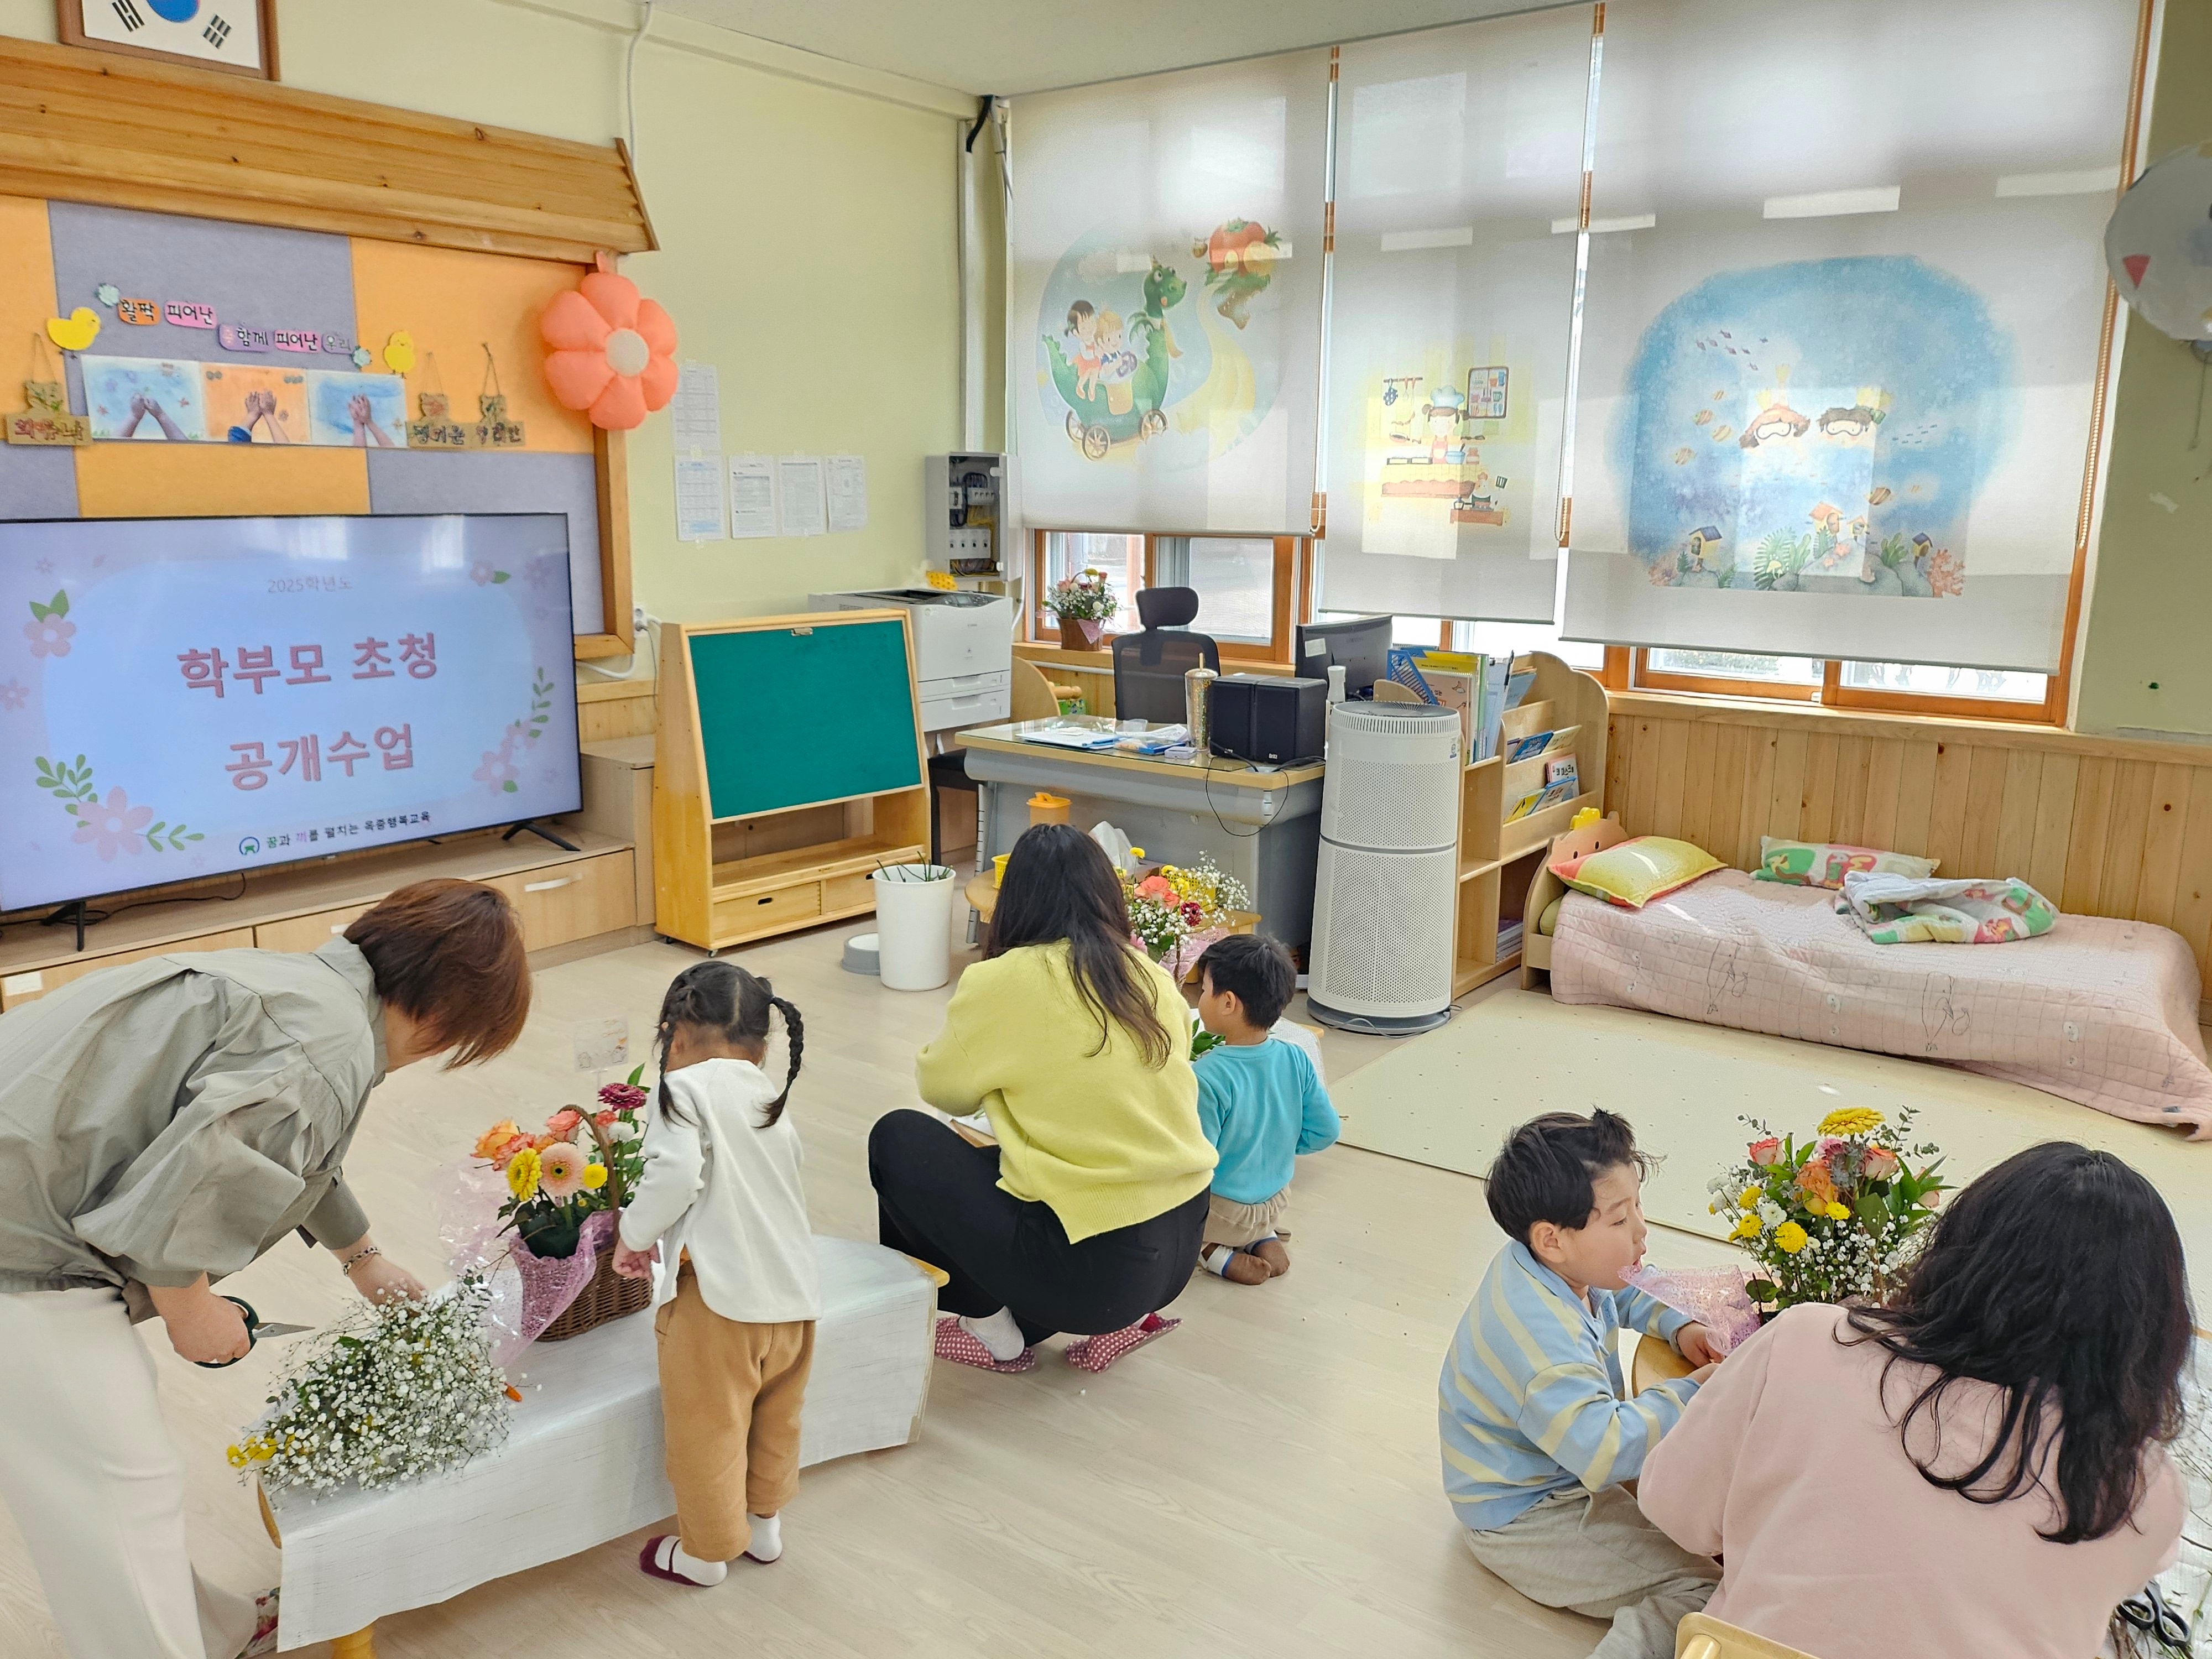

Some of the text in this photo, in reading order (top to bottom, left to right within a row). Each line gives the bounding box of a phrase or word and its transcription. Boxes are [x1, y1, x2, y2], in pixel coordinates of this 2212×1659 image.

[119, 299, 213, 325] 활짝 피어난
[236, 327, 269, 347] 함께
[276, 333, 317, 351] 피어난
[325, 334, 352, 351] 우리
[268, 574, 354, 594] 2025학년도
[177, 632, 437, 698] 학부모 초청
[225, 723, 413, 791] 공개수업
[267, 833, 291, 849] 꿈과
[325, 824, 359, 839] 펼치는
